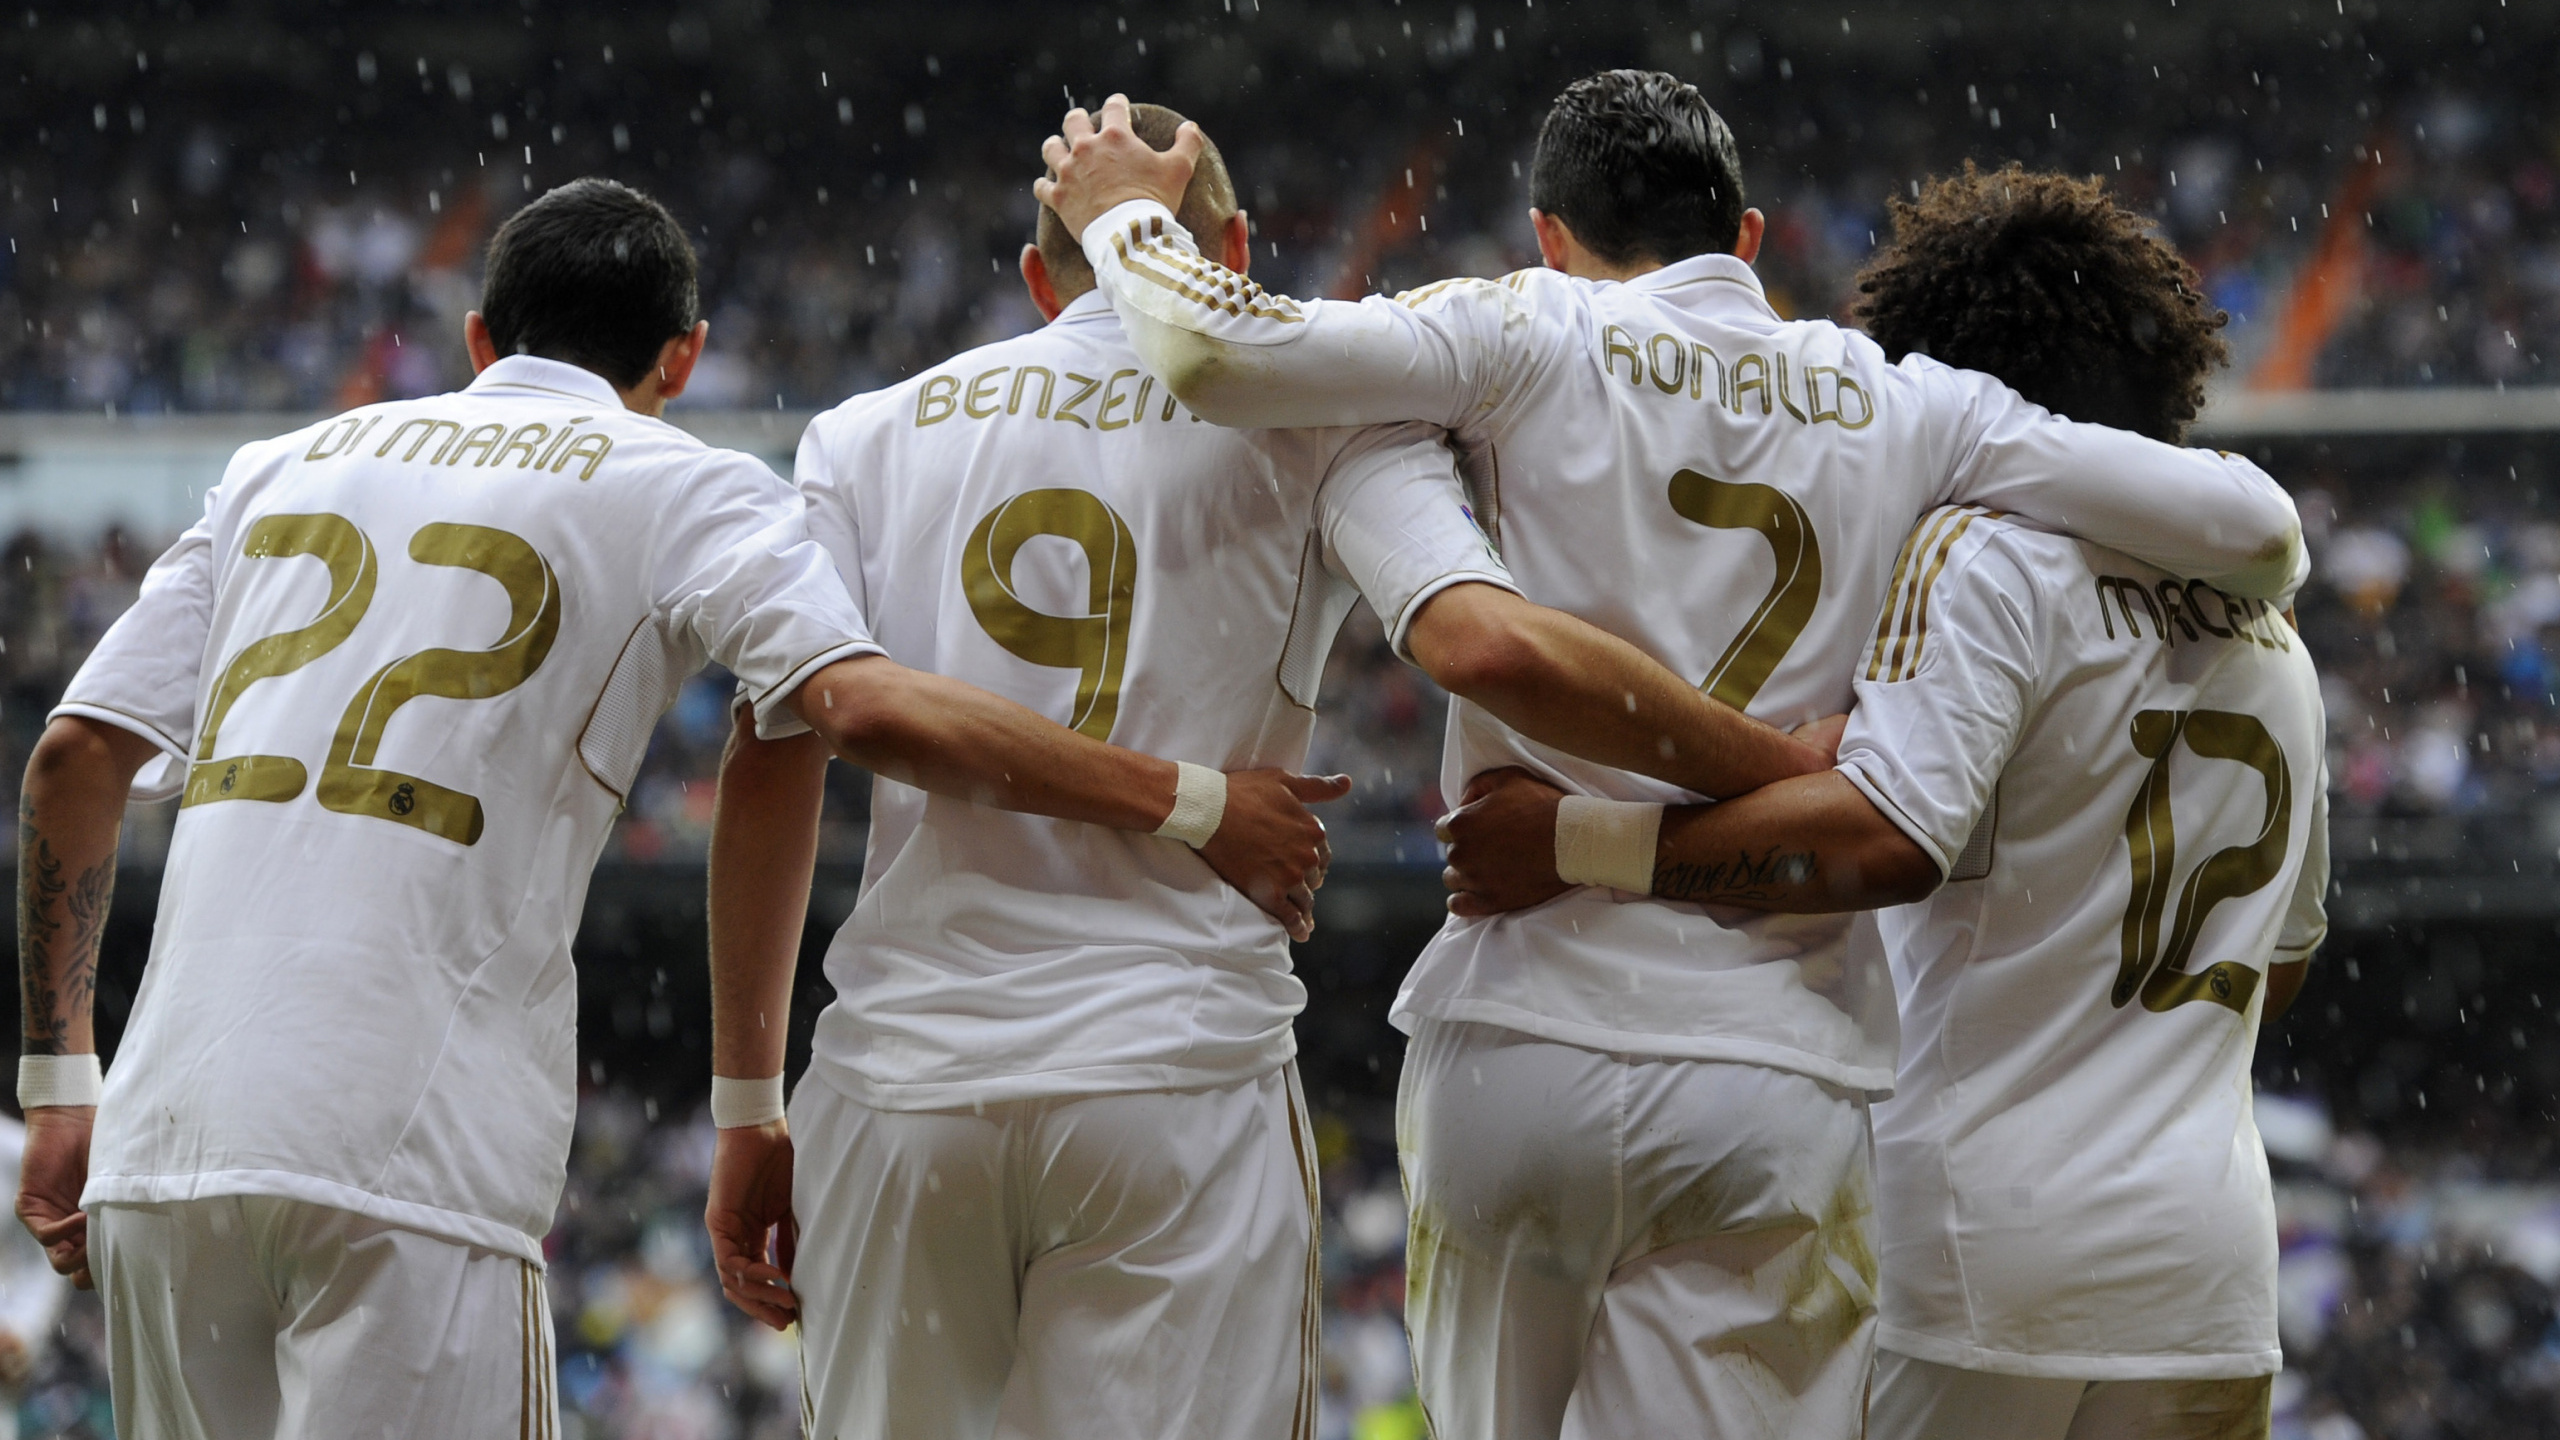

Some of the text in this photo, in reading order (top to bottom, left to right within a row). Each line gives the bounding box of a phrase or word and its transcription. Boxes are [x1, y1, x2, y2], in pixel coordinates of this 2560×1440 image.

[303, 414, 614, 482] DI MARÍA
[1602, 323, 1875, 431] RONALDO
[180, 512, 562, 847] 22
[961, 487, 1138, 744] 9
[1667, 468, 1823, 713] 7
[2111, 708, 2292, 1014] 12
